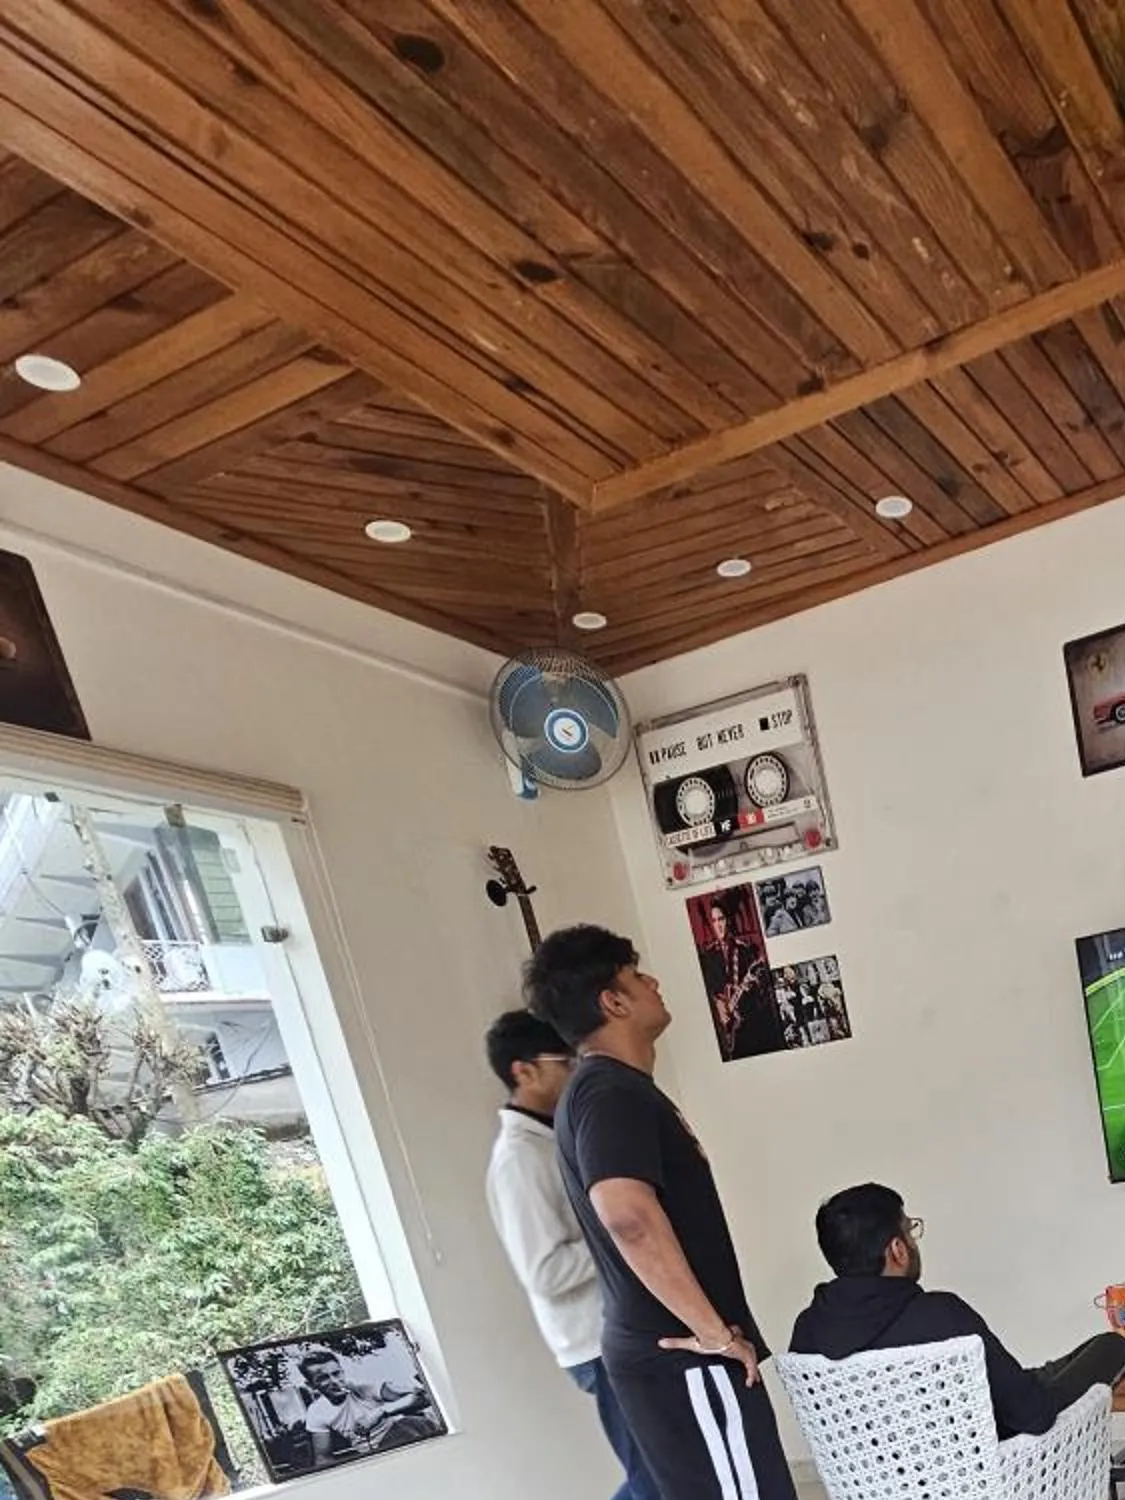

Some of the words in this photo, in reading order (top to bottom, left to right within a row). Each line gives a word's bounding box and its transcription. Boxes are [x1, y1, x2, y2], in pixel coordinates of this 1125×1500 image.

[661, 742, 686, 760] PAUSE
[696, 733, 713, 751] BUT
[717, 723, 744, 744] NEVER
[771, 709, 793, 729] STOP
